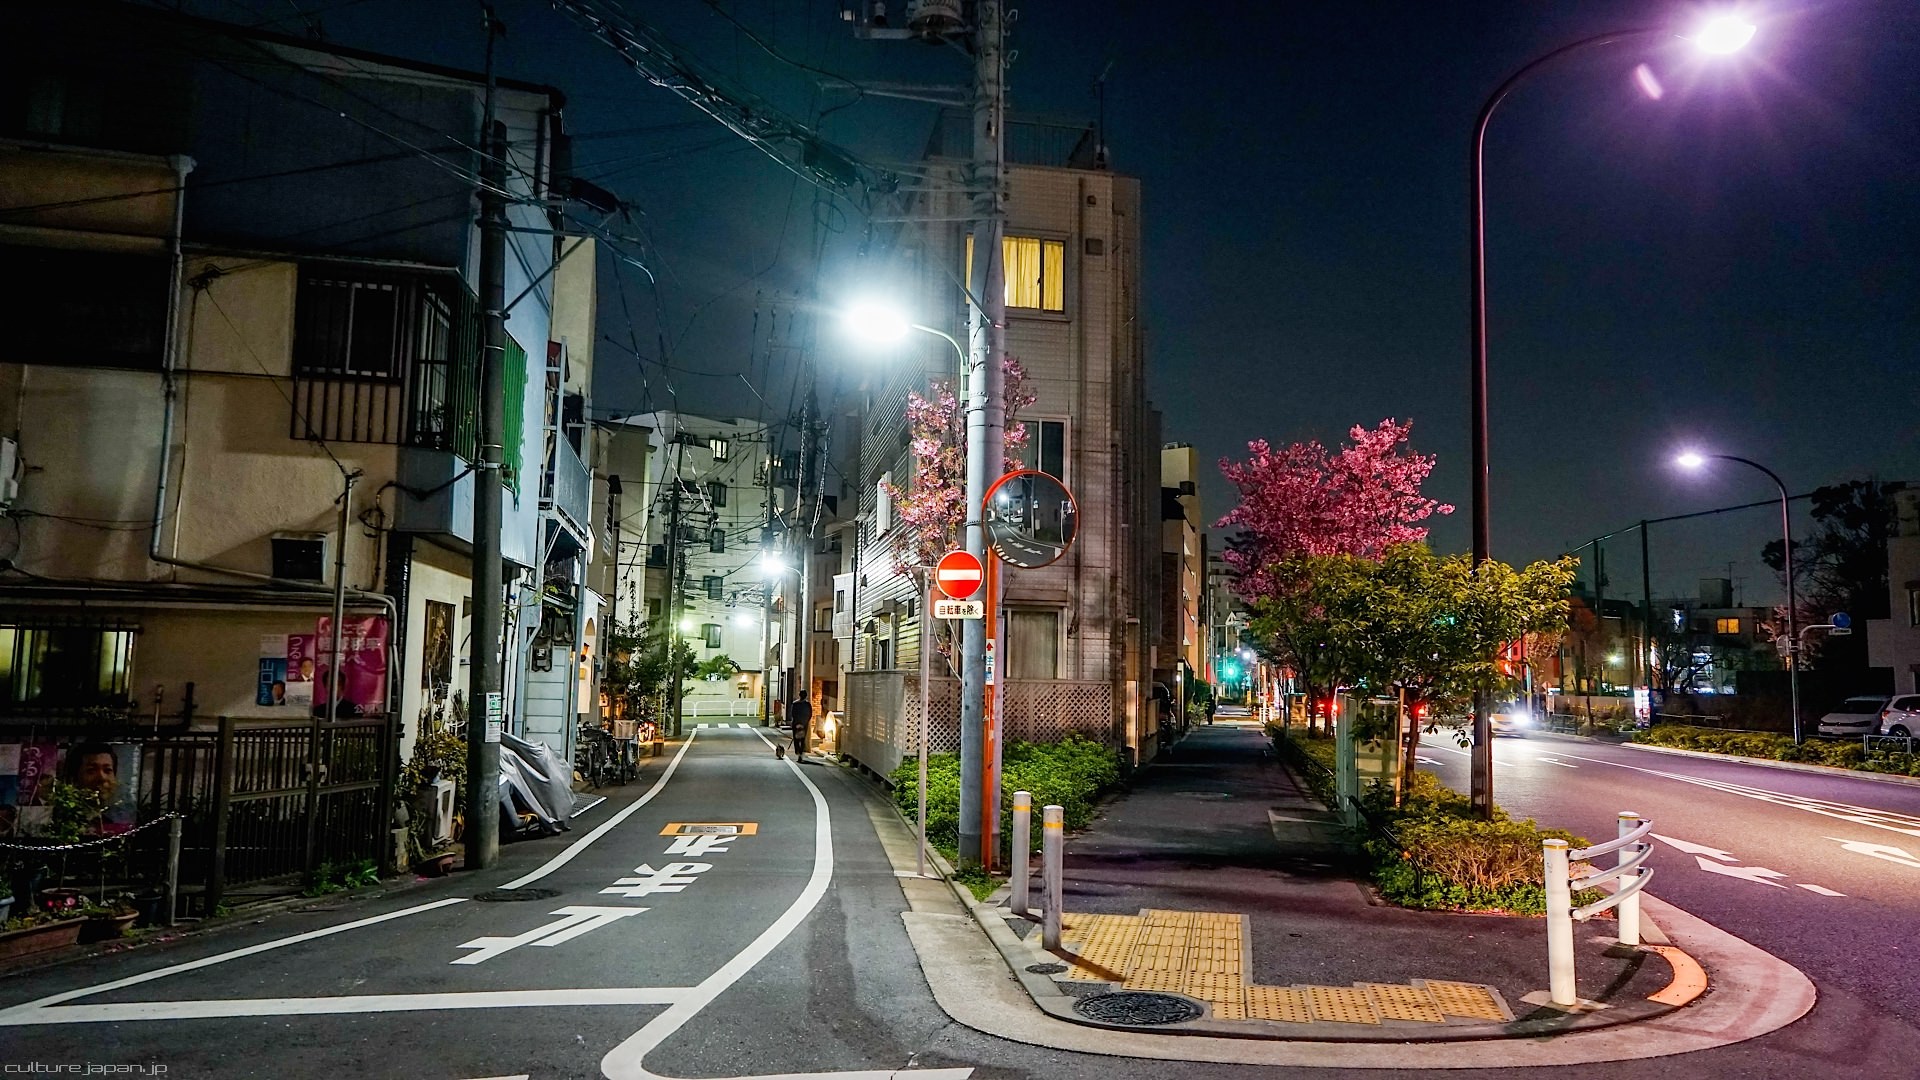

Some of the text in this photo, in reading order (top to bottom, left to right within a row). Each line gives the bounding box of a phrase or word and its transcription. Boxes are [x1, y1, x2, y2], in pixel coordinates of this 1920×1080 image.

[939, 604, 979, 616] 自転車を除く
